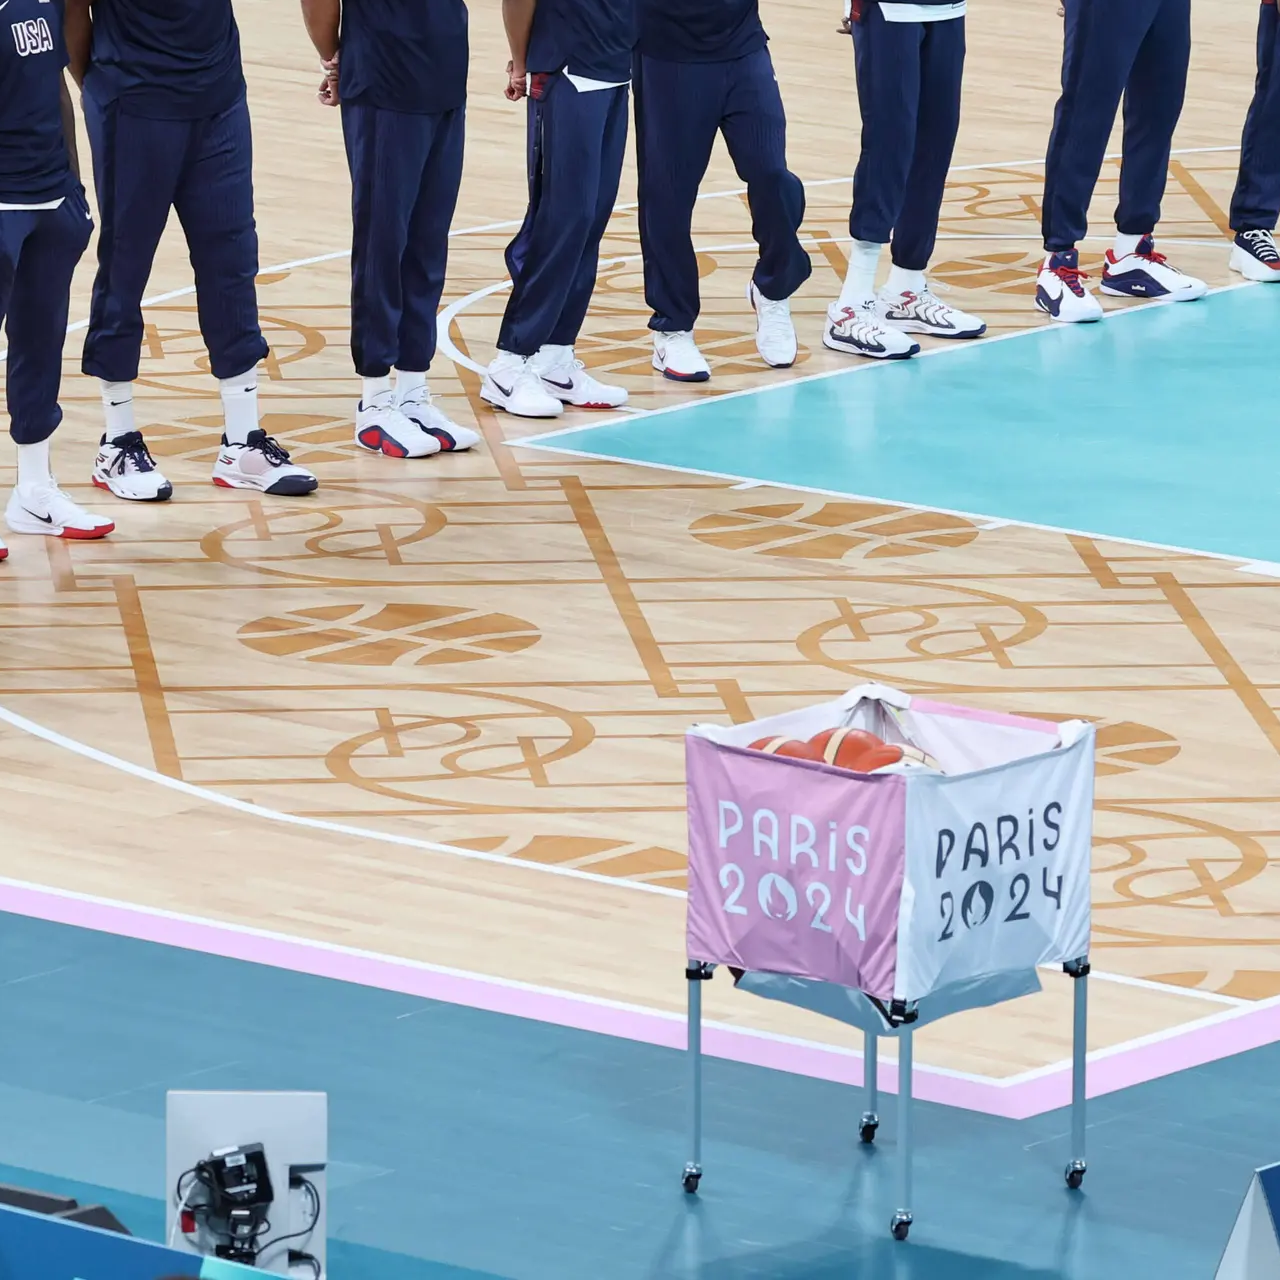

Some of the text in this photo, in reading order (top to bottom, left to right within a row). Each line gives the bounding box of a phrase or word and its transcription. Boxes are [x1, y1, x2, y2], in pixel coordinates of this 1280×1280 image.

[10, 16, 54, 57] USA
[718, 863, 866, 942] 2024
[937, 867, 1064, 943] 2024
